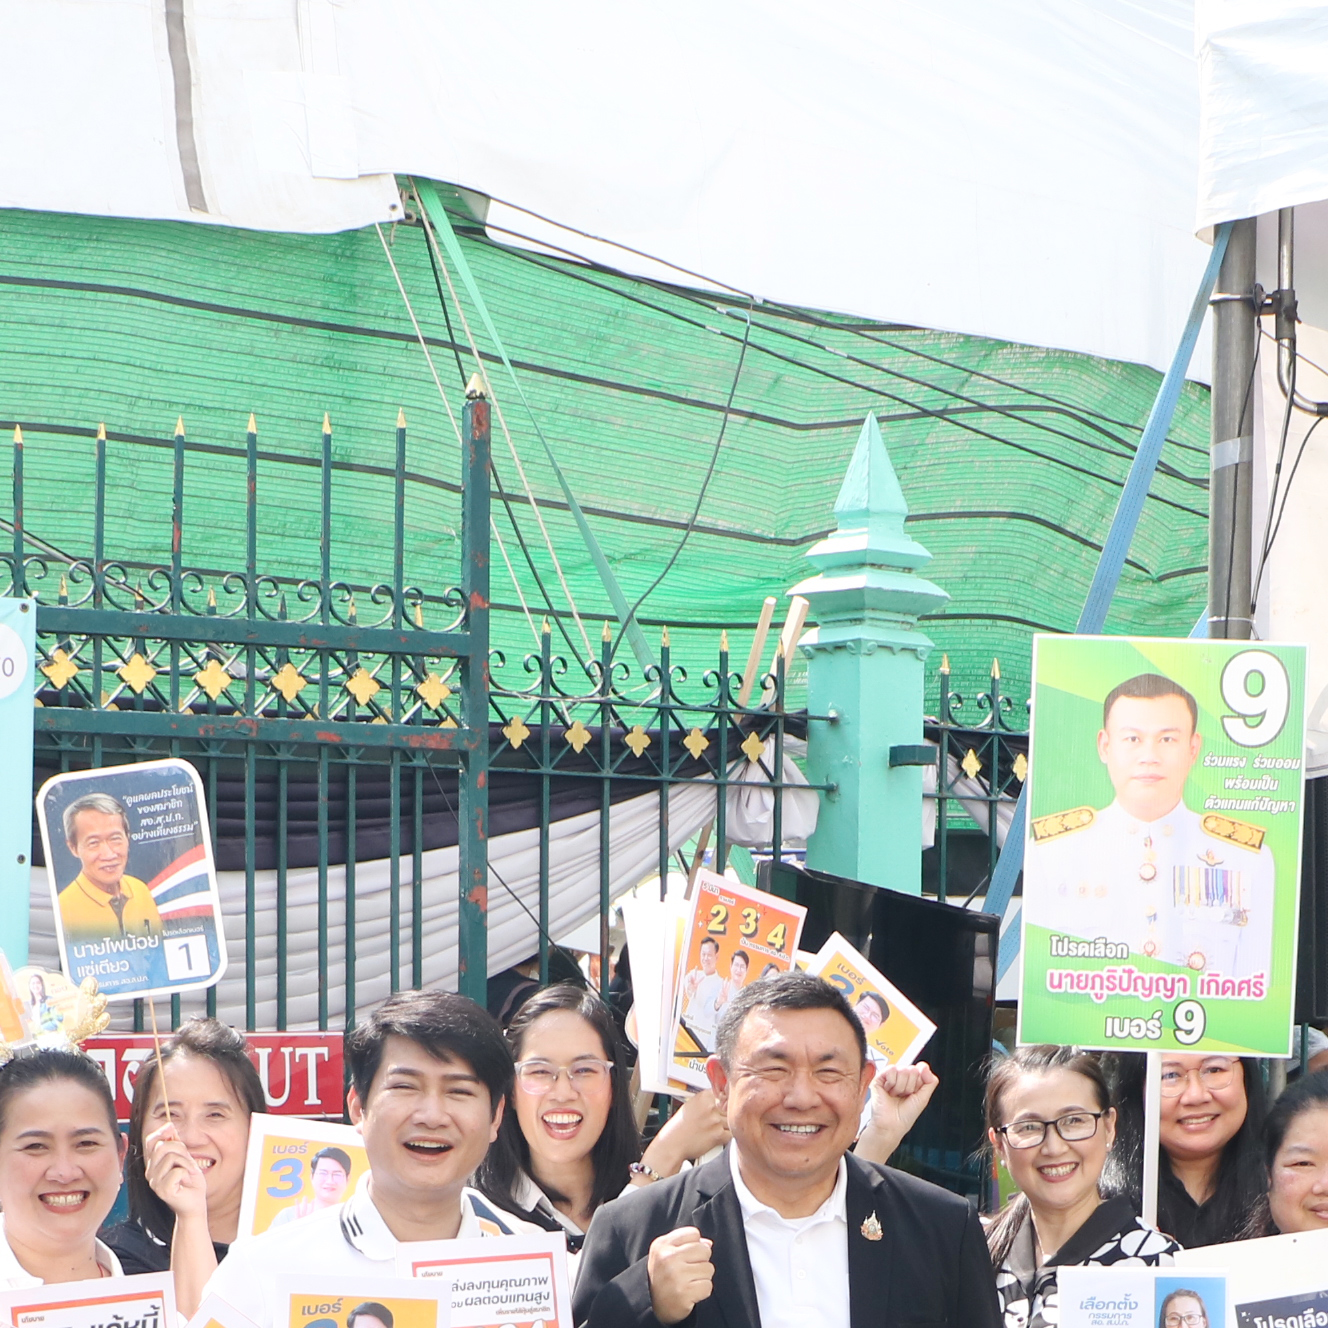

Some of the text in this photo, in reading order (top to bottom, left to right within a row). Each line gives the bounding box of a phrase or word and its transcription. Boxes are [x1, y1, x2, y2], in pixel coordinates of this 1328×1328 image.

[1220, 649, 1290, 748] 9
[707, 904, 786, 951] 2 3 4
[74, 934, 159, 959] นายไพน้อย
[178, 942, 193, 971] 1
[1050, 935, 1128, 960] โปรดเลือก
[1049, 968, 1264, 1000] นายภูริปัญญา เกิดศรี
[1105, 1000, 1206, 1044] เบอร์ 9
[272, 1140, 310, 1155] เบอร์
[267, 1158, 303, 1197] 3
[302, 1298, 343, 1316] เบอร์
[1079, 1293, 1139, 1311] เลือกตั้ง
